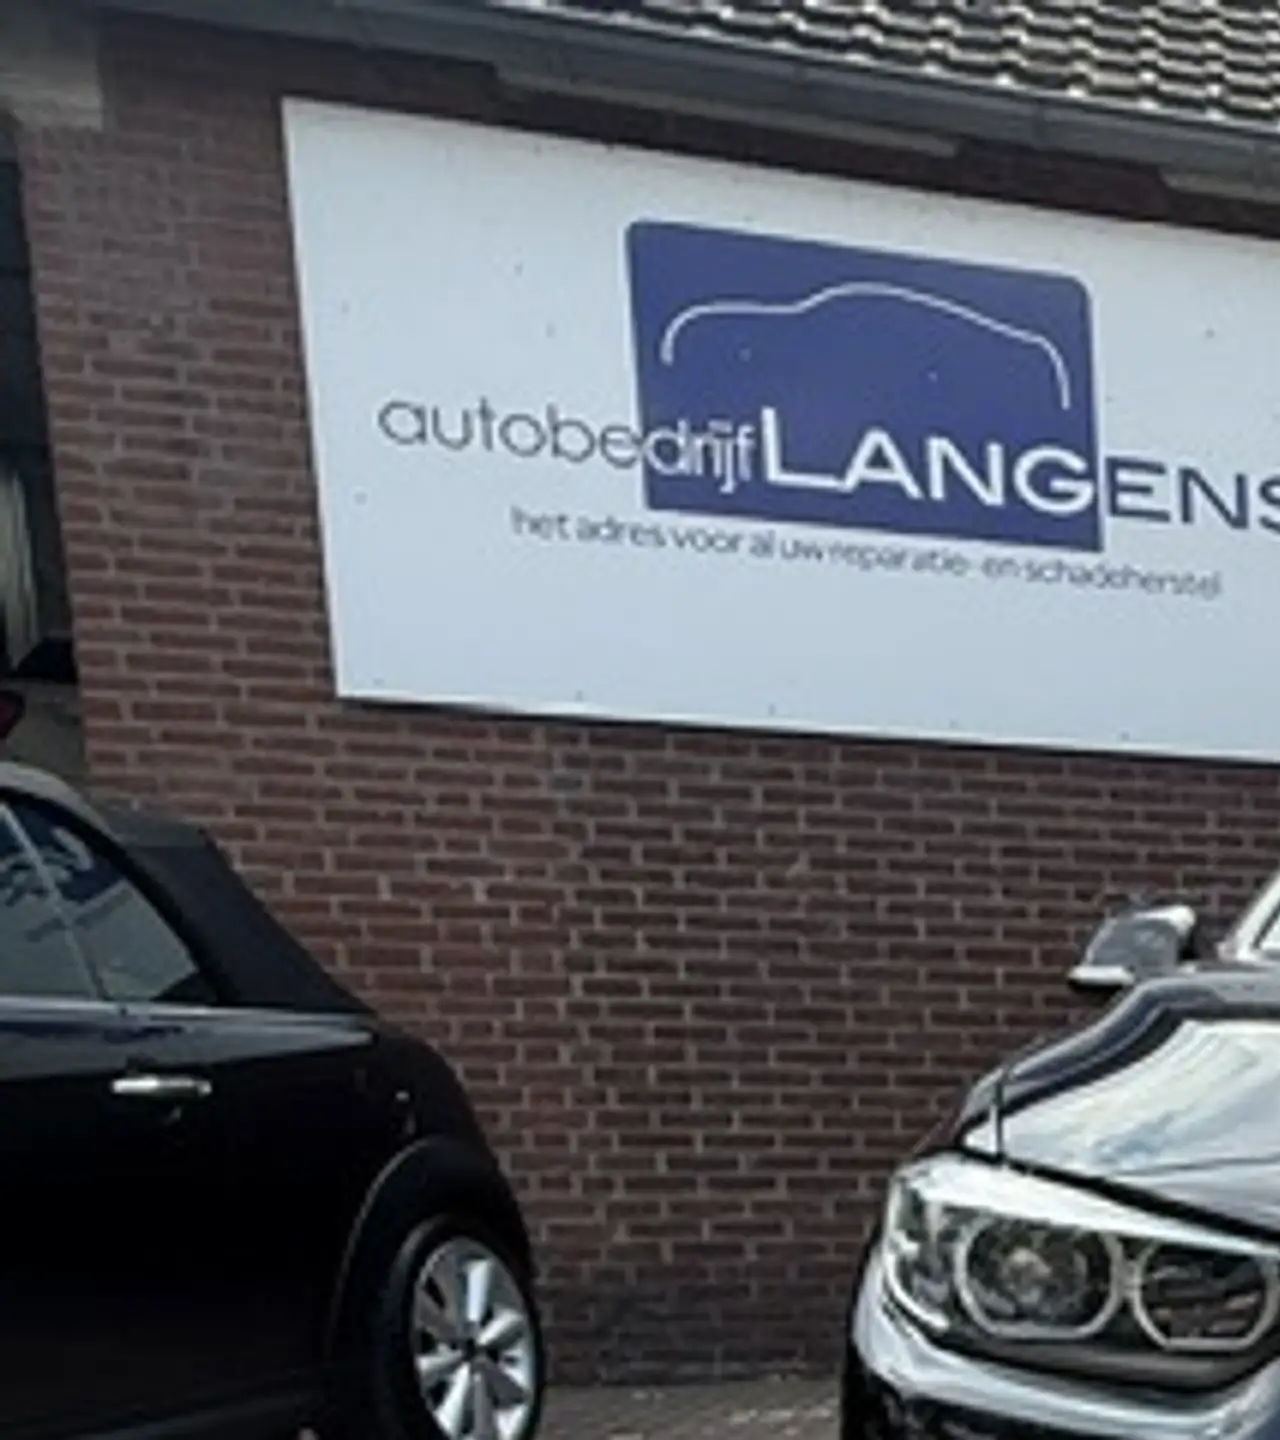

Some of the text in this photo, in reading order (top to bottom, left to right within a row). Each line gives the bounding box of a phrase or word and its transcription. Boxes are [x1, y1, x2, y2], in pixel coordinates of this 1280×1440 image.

[377, 396, 755, 494] autobedrijf
[510, 504, 571, 542] het
[575, 513, 664, 550] adres
[669, 526, 741, 556] voor
[749, 528, 776, 560] al
[780, 539, 823, 562] uw
